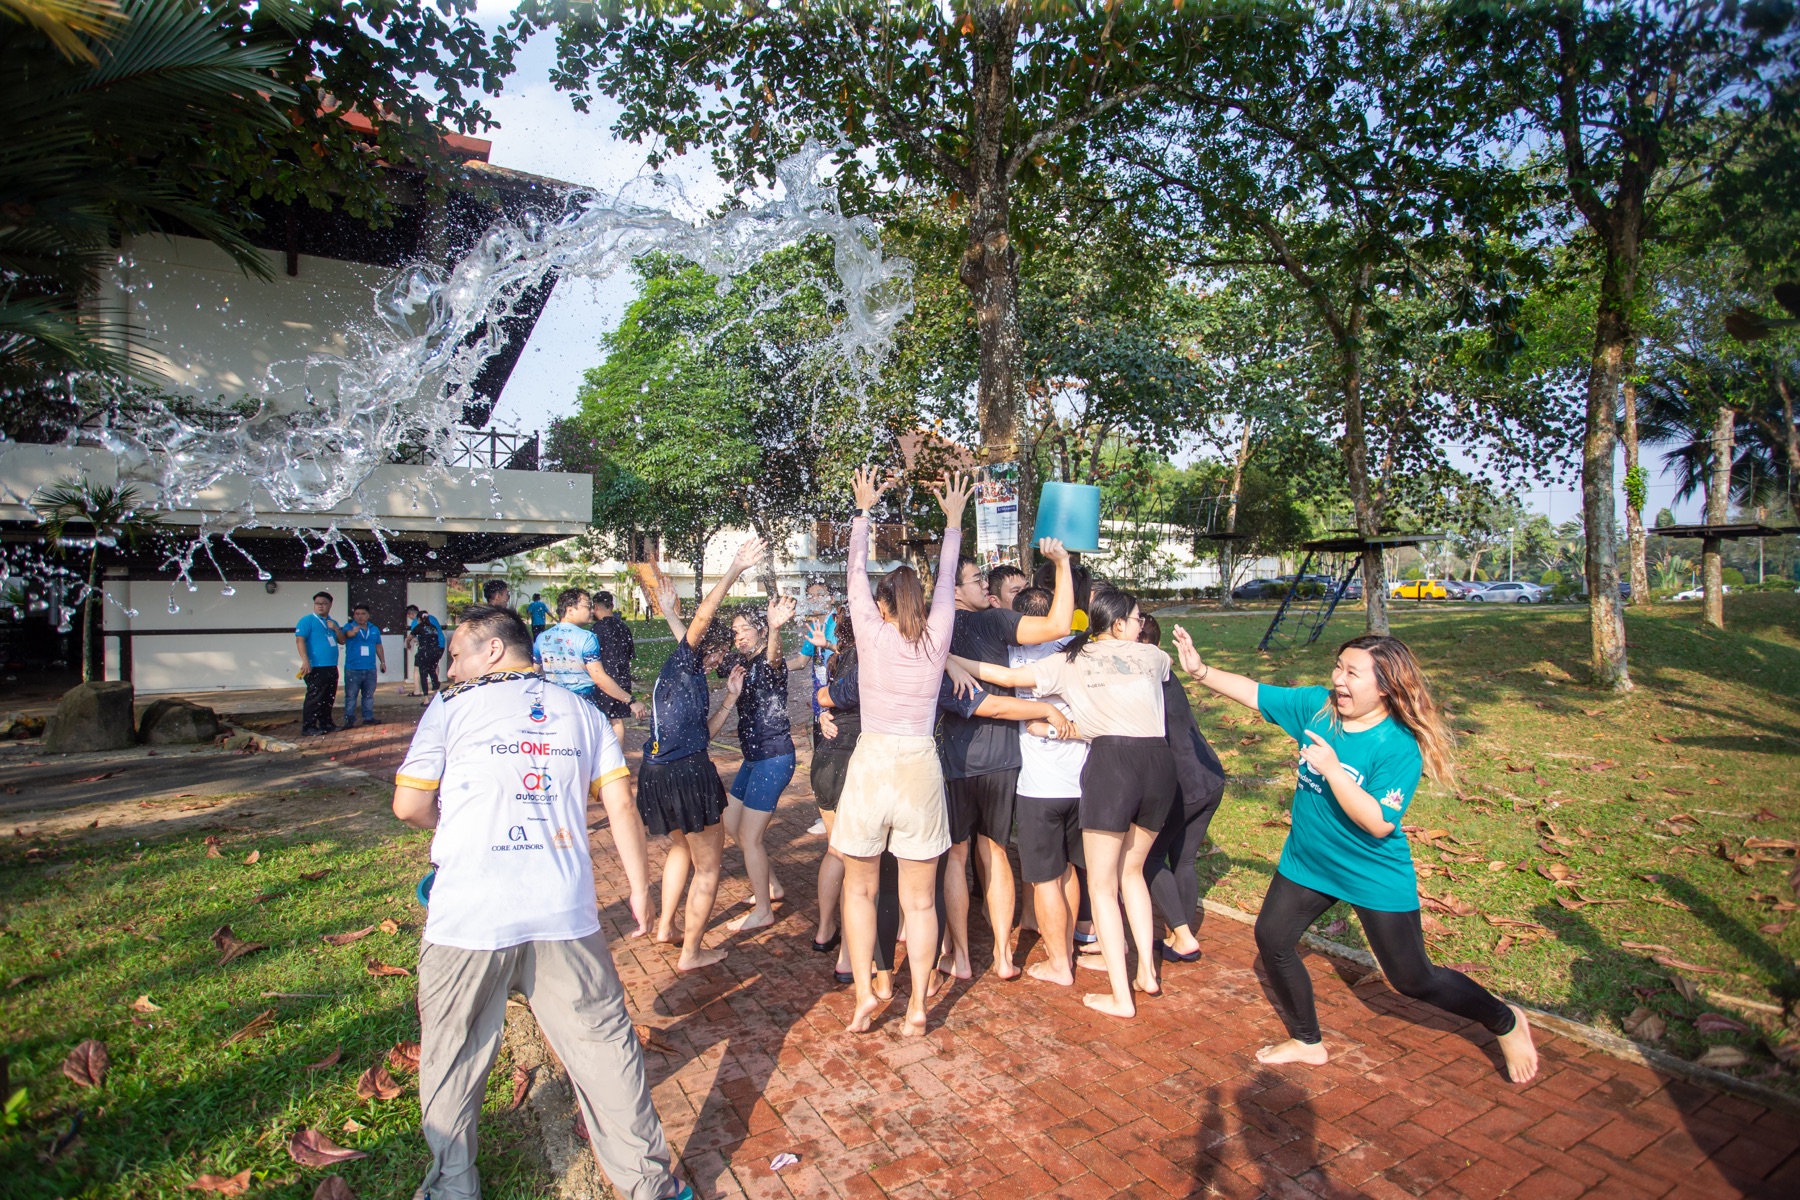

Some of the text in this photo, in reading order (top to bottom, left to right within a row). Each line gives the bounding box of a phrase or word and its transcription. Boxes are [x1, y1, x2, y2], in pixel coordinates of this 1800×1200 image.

[516, 793, 558, 802] autocount
[491, 843, 544, 852] CORE ADVISORS
